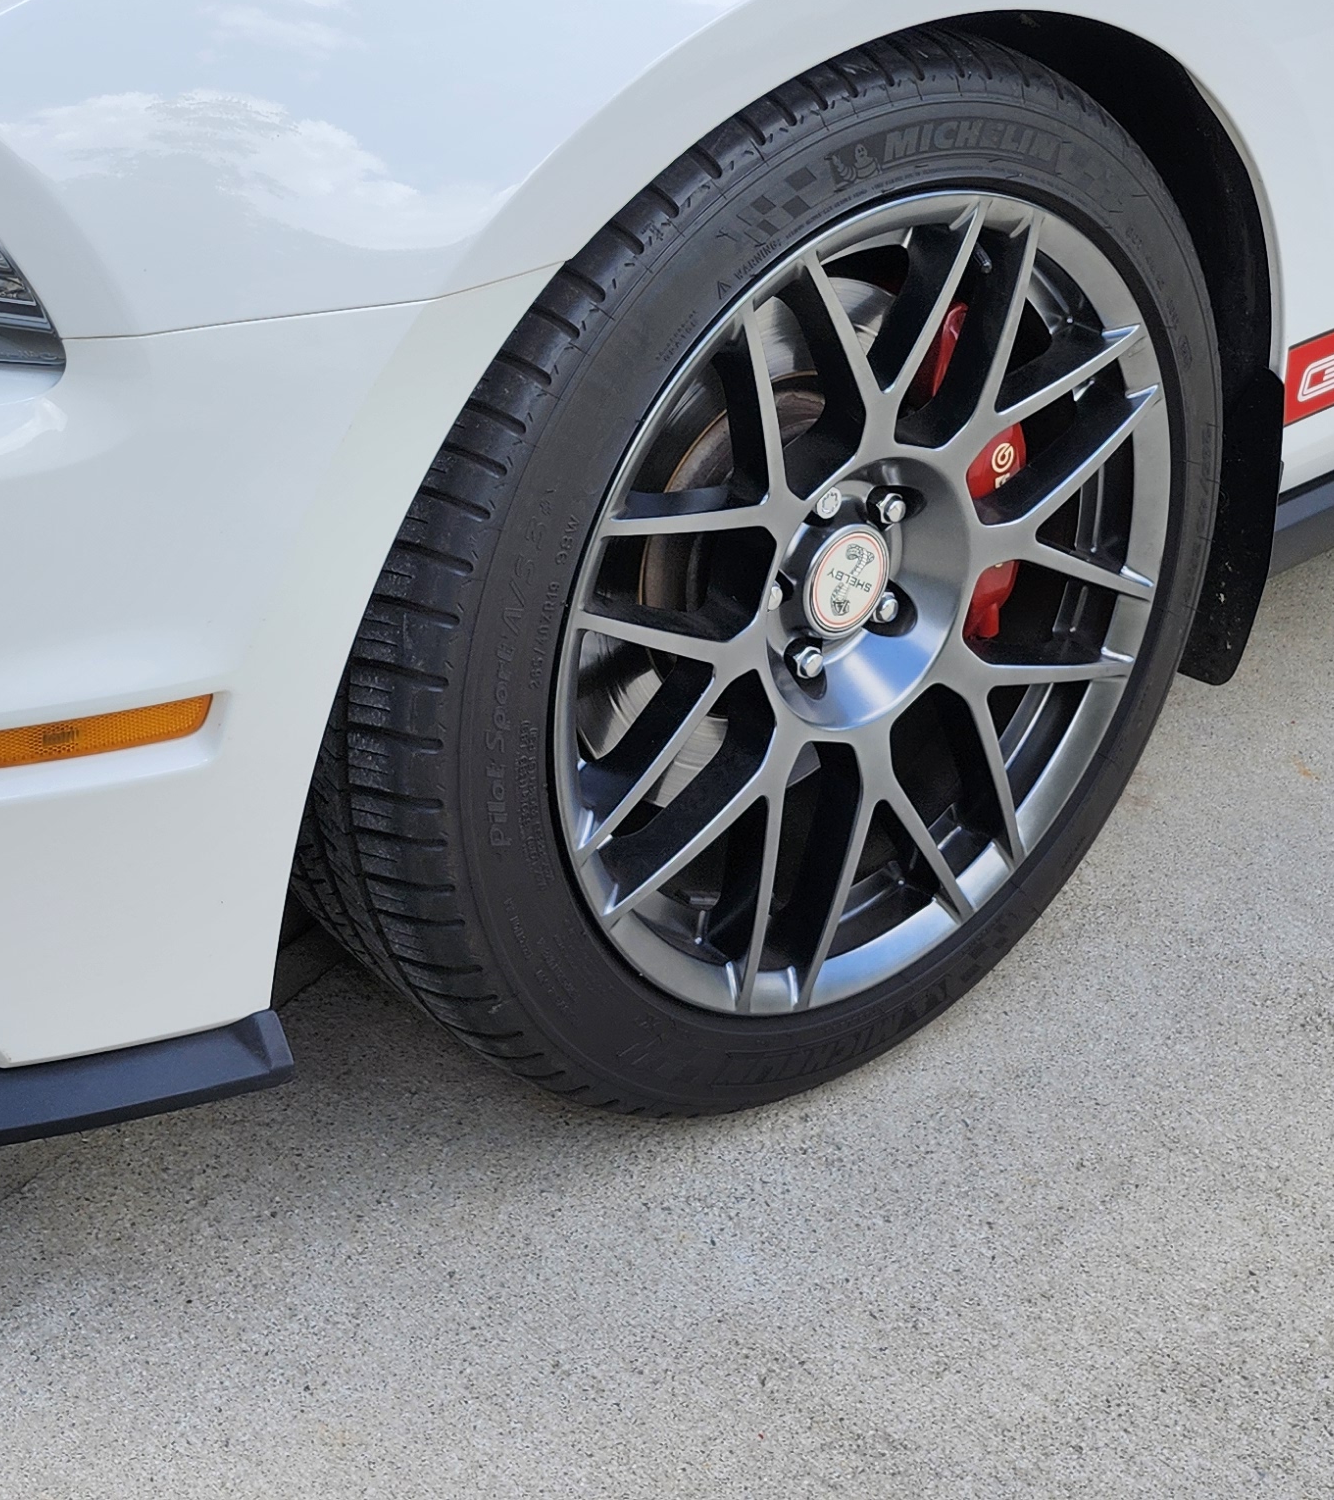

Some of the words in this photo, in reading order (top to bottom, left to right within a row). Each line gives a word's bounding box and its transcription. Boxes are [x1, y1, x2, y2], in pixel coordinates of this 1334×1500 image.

[883, 119, 1060, 163] MICHELIN
[503, 553, 536, 637] A/S
[827, 568, 872, 593] SHELBY
[485, 642, 516, 753] Sport
[485, 761, 513, 846] Pilot
